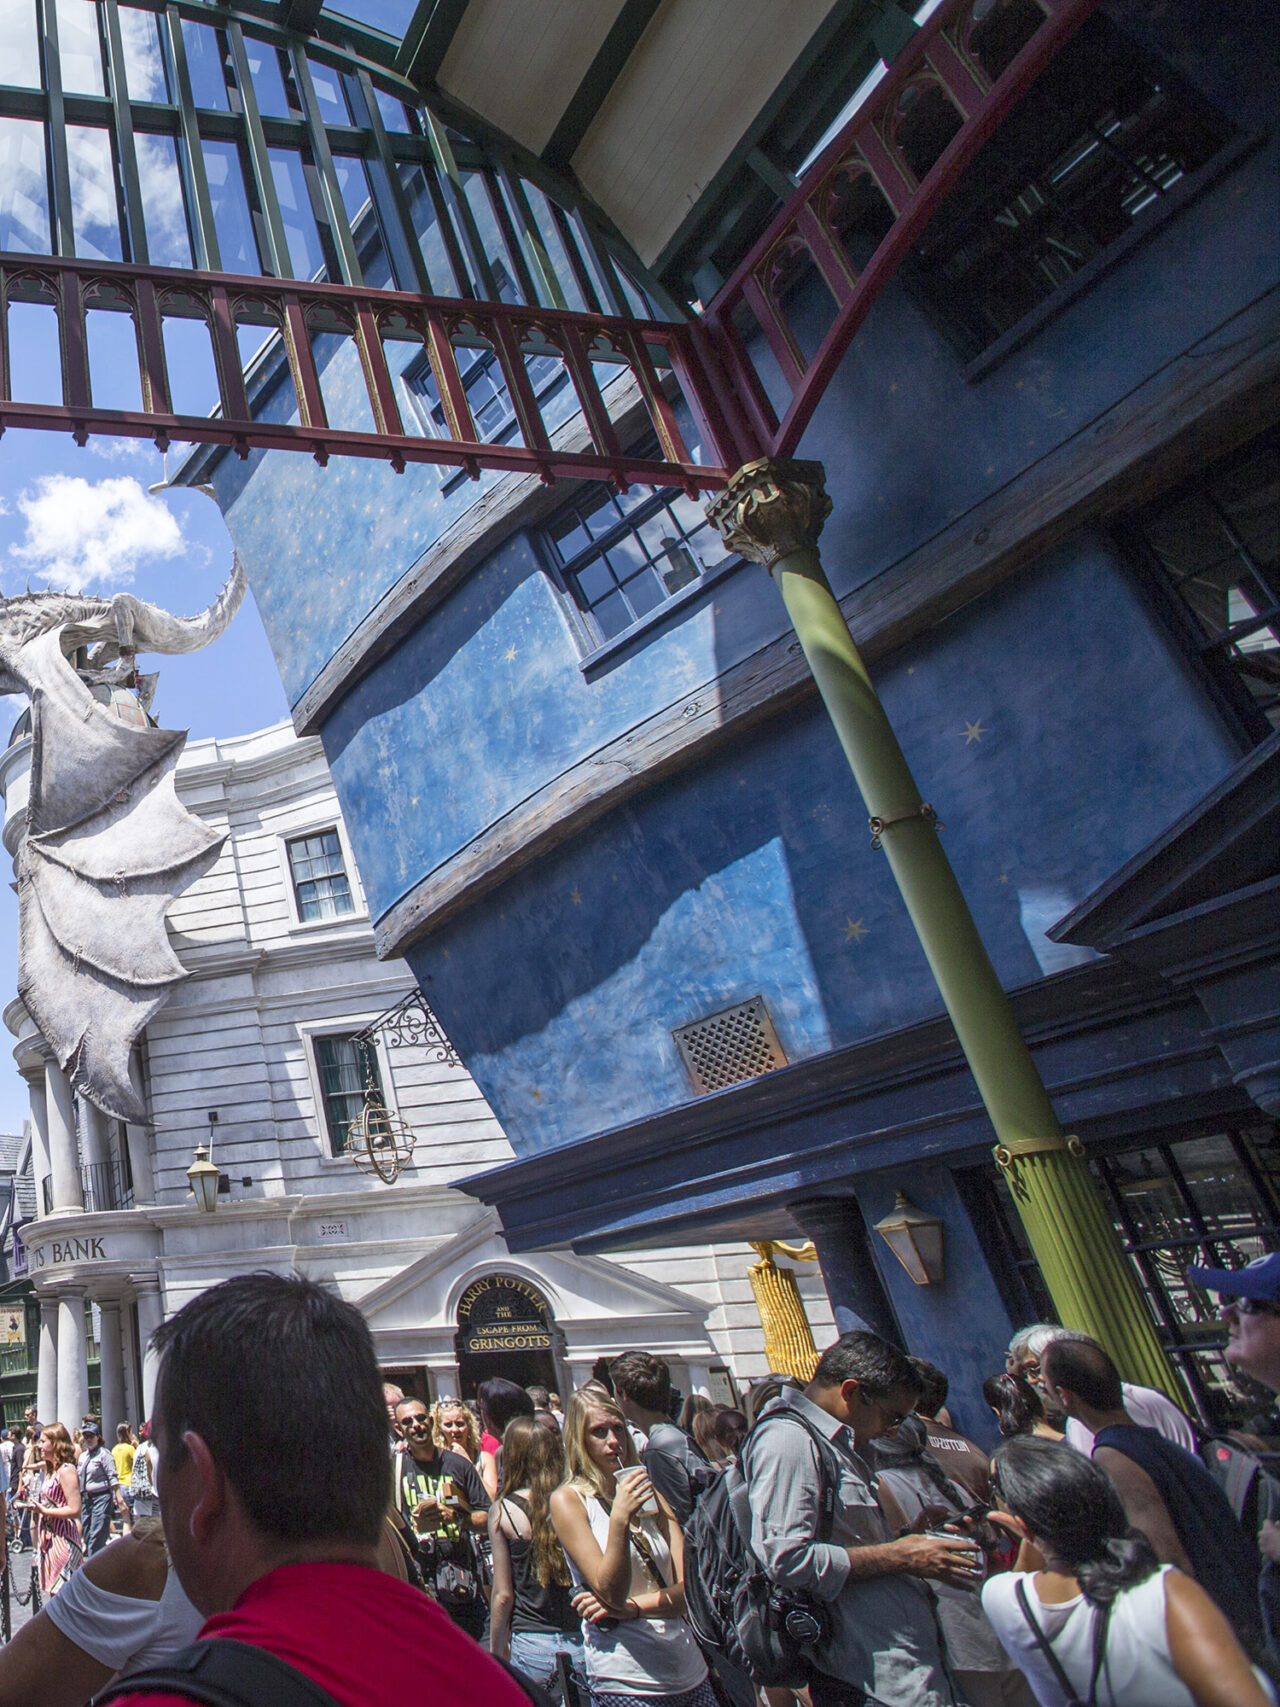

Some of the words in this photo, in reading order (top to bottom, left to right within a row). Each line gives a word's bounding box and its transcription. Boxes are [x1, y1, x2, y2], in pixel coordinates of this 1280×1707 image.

[52, 1237, 107, 1264] BANK
[459, 1278, 491, 1316] HARRY
[495, 1276, 548, 1313] POTTER
[477, 1326, 509, 1335] ESCAPE
[512, 1324, 538, 1333] FROM
[469, 1335, 551, 1351] GRINGOTTS
